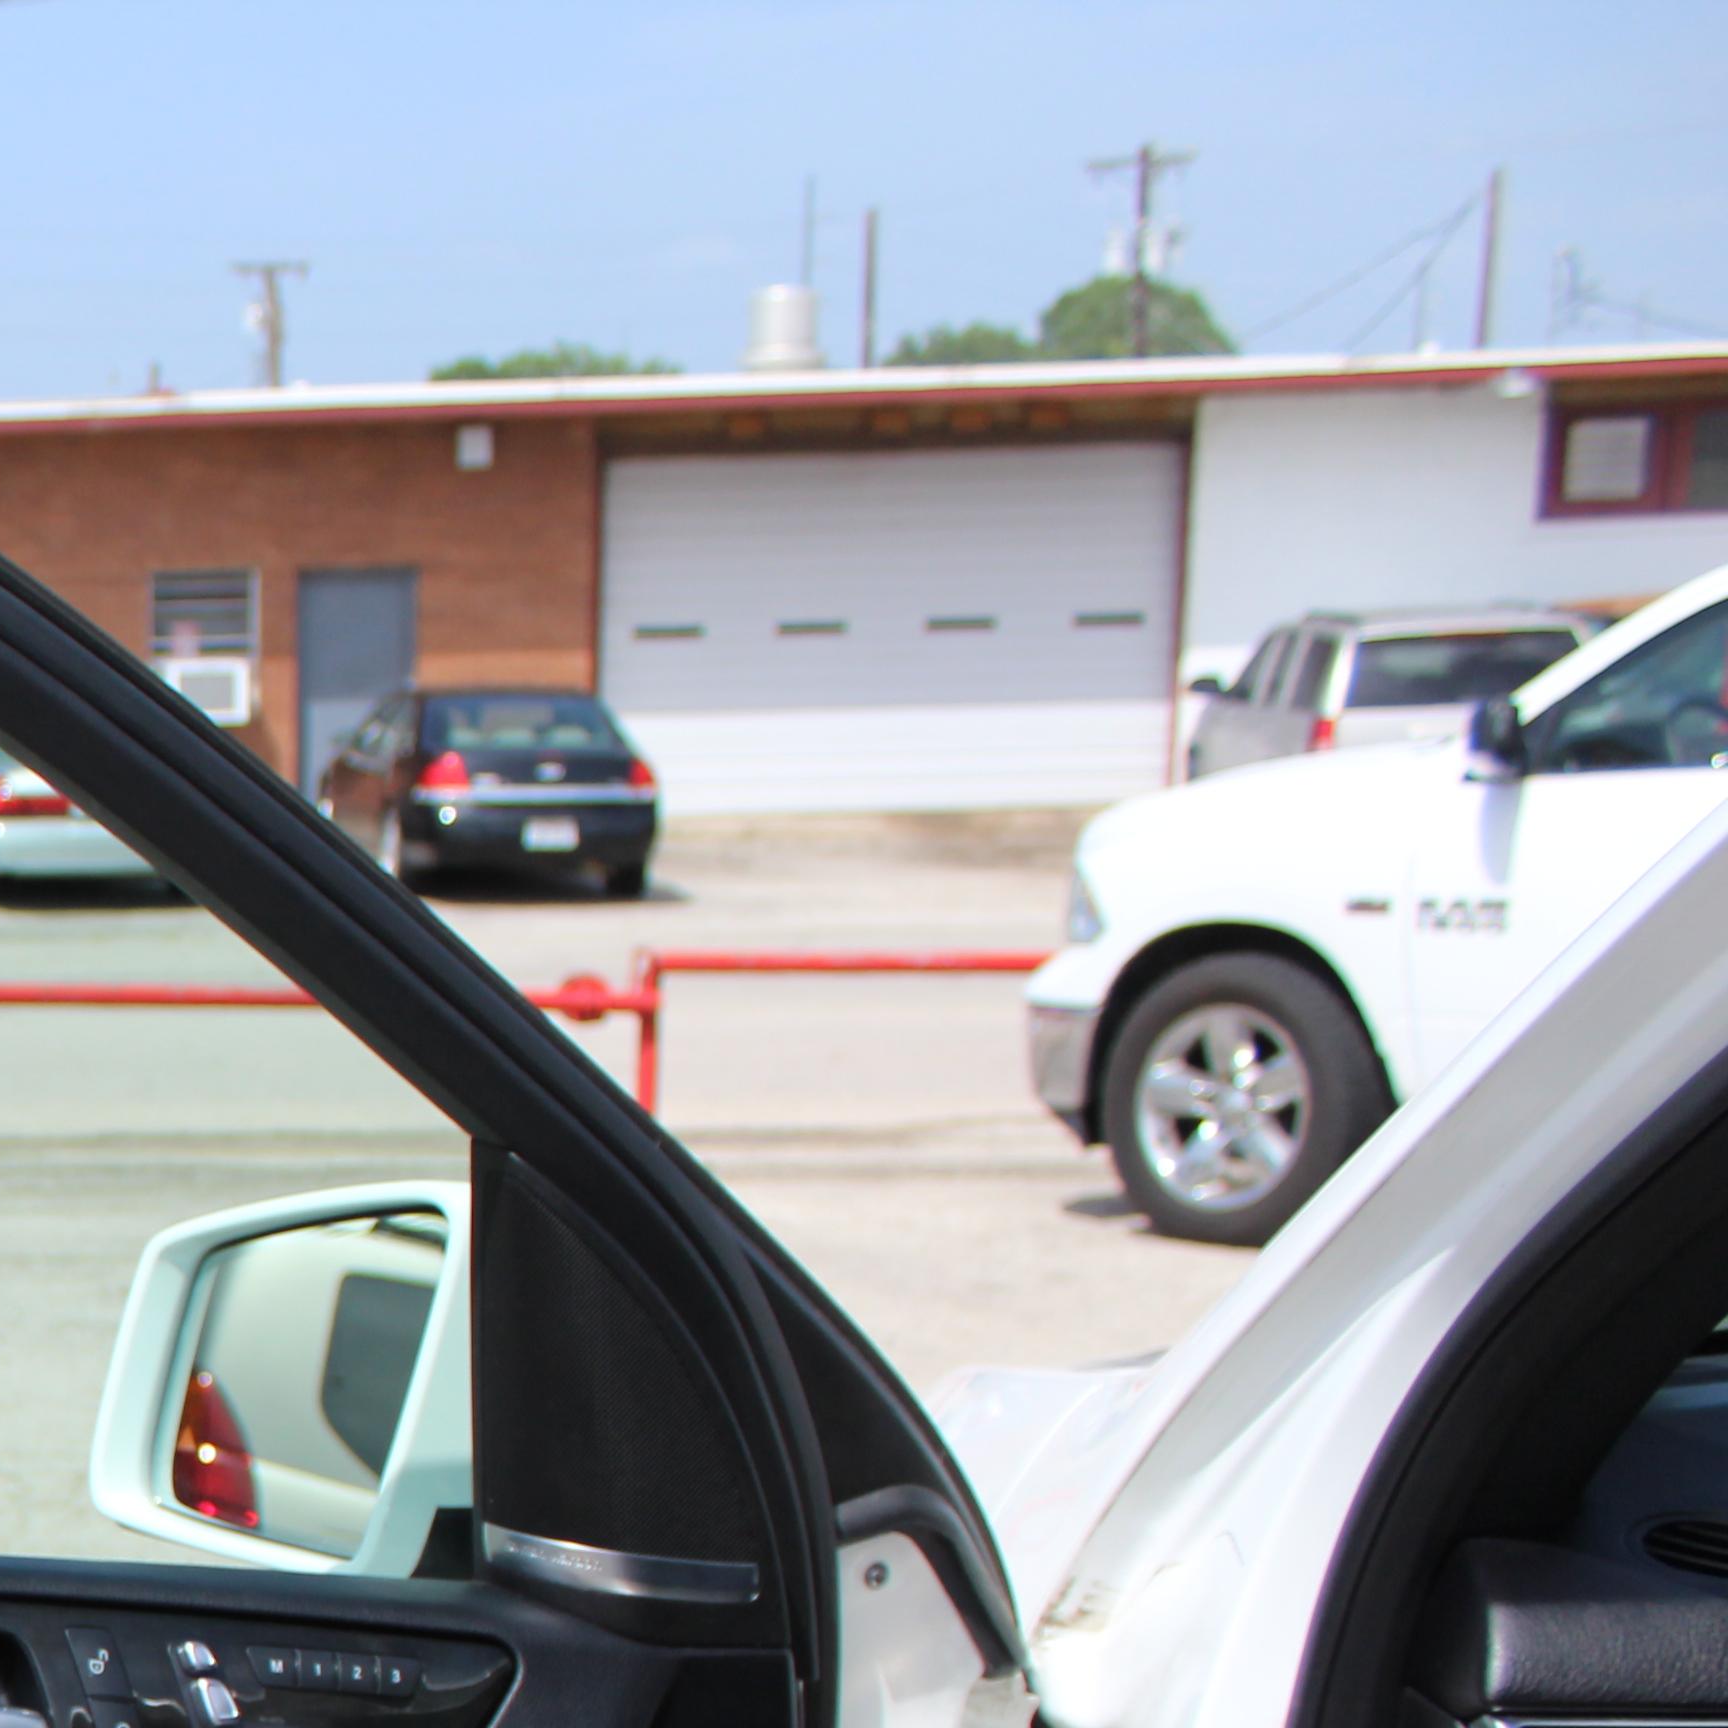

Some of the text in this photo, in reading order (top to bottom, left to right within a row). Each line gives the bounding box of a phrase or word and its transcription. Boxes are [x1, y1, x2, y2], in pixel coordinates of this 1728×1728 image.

[269, 1658, 402, 1684] M 1 2 3
